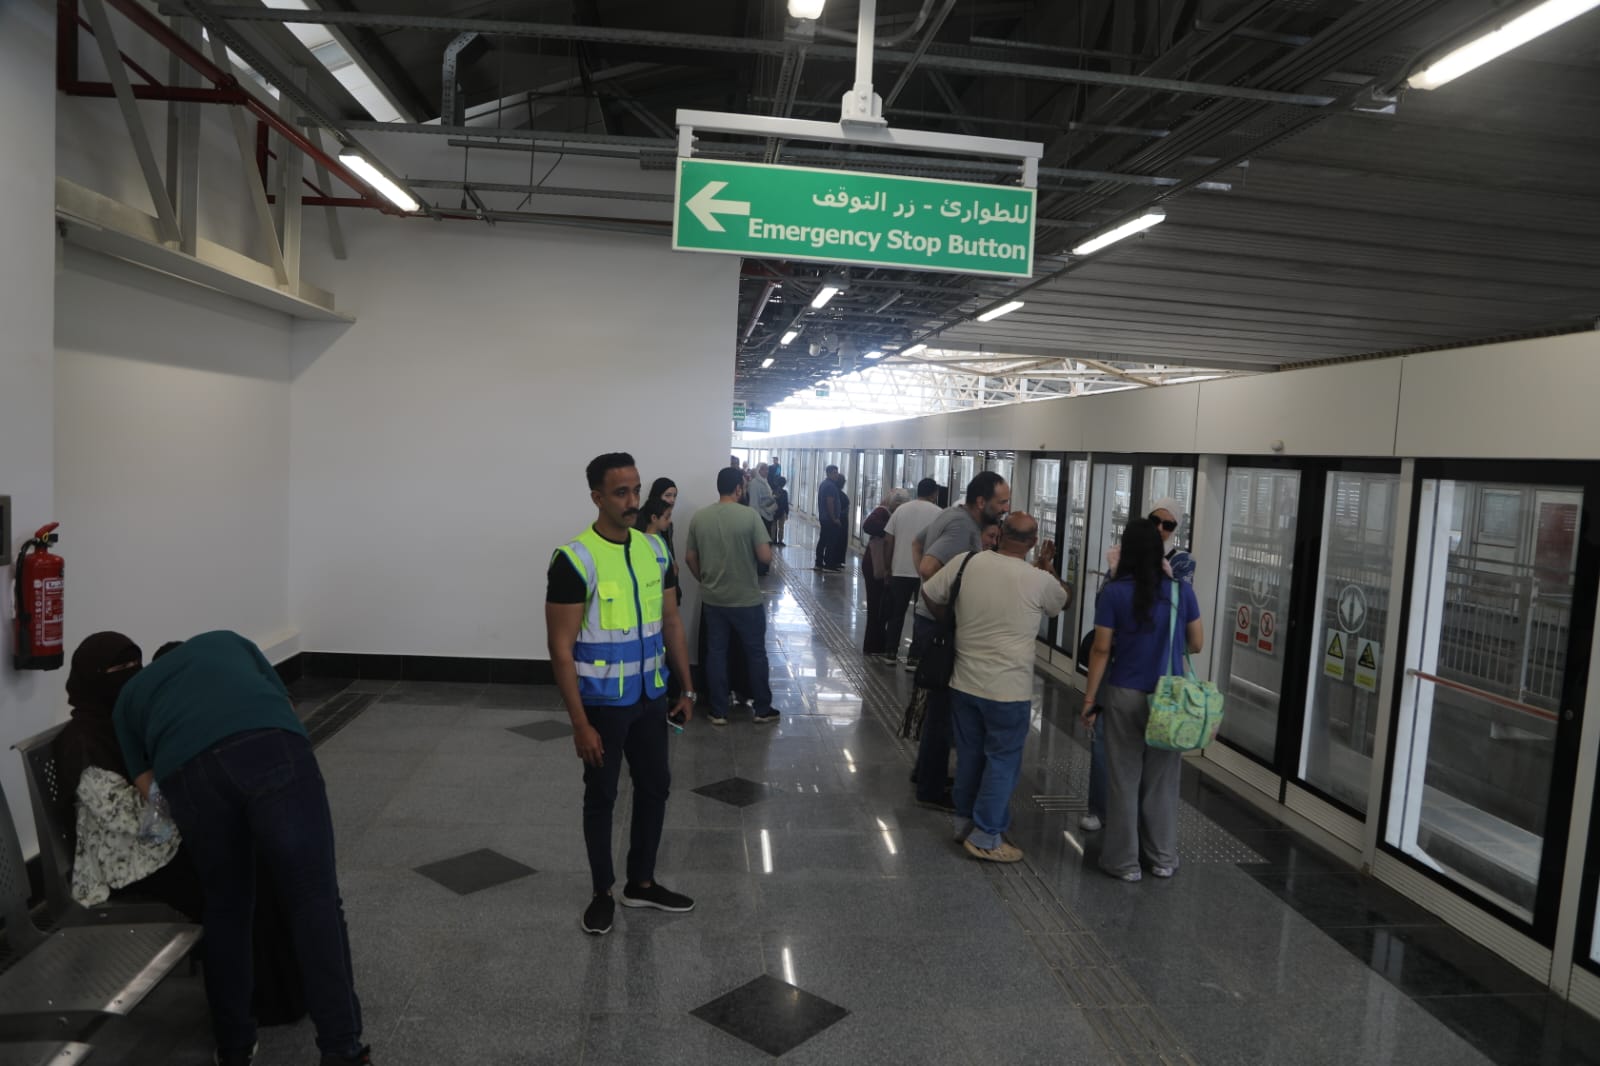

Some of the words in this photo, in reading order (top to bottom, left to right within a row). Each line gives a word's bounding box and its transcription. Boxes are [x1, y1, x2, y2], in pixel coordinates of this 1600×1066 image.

[812, 186, 887, 213] التوقف
[893, 200, 915, 218] زر
[940, 198, 1028, 225] للطوارئ
[748, 218, 882, 252] Emergency
[887, 229, 941, 256] Stop
[948, 234, 1026, 260] Button
